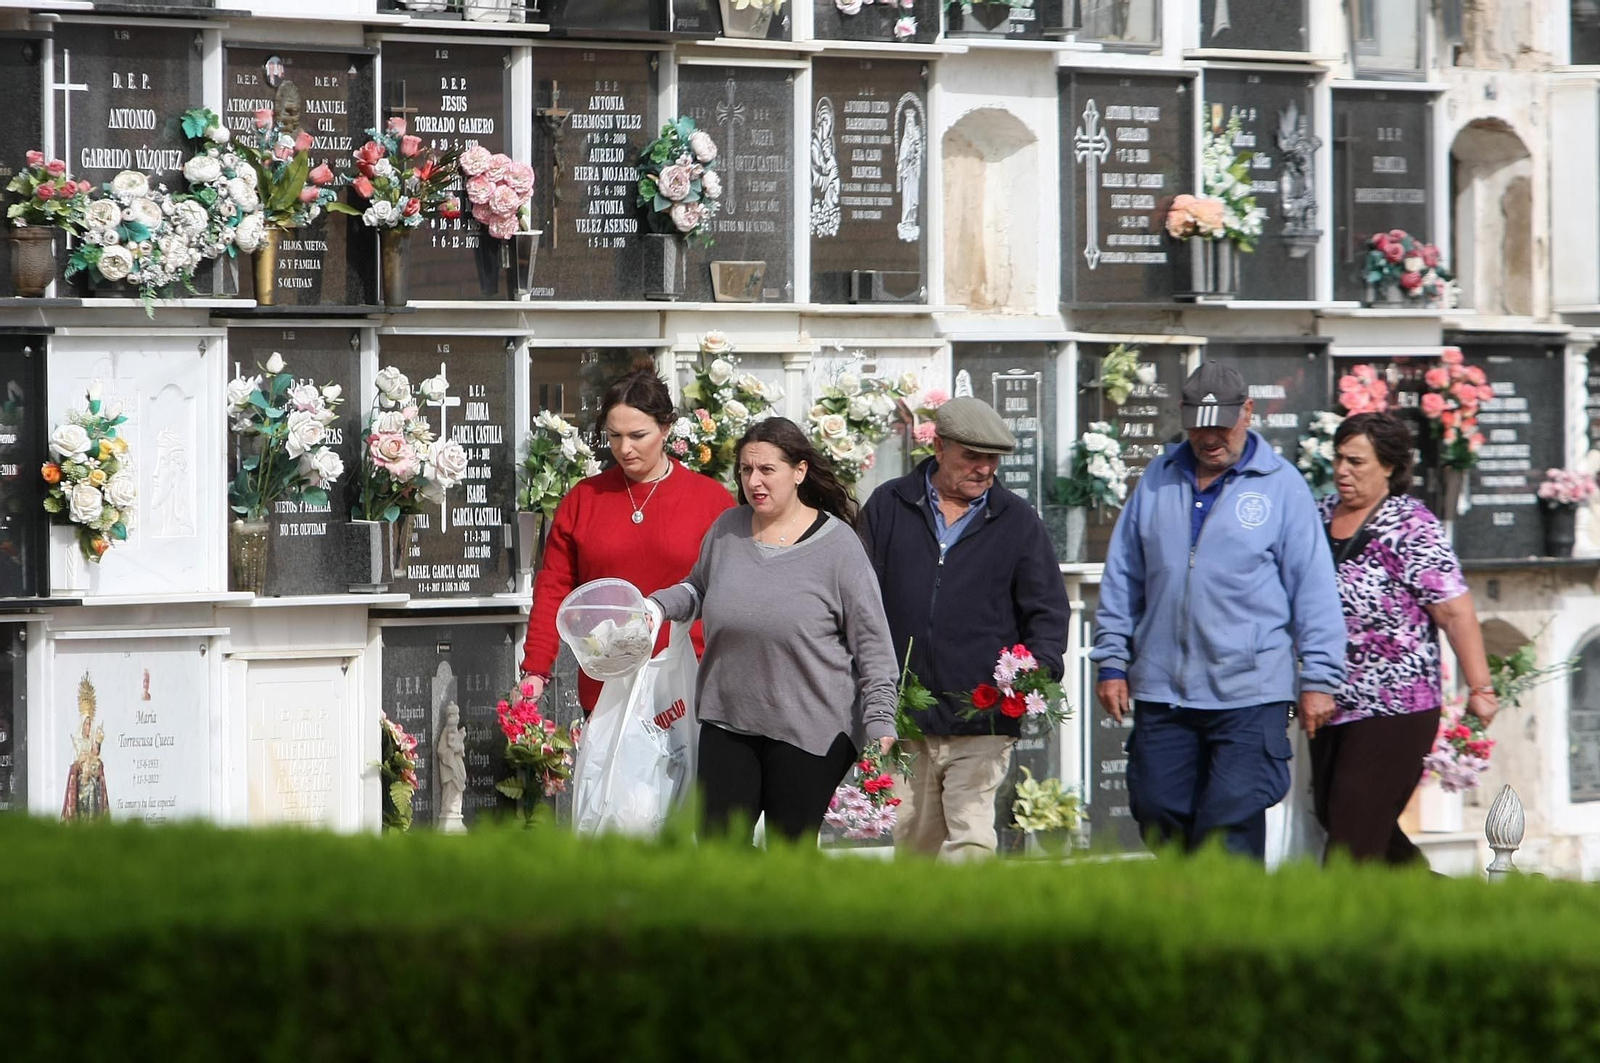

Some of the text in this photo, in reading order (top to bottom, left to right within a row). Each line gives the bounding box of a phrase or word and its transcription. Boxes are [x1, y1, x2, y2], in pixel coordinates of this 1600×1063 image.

[306, 100, 347, 115] MANUEL
[440, 95, 468, 112] JESUS
[588, 95, 624, 111] ANTONIA
[108, 108, 156, 130] ANTONIO
[317, 118, 335, 132] GIL
[414, 116, 494, 134] TORRADO GAMERO
[571, 114, 642, 130] HERMOSIN VELEZ
[81, 144, 183, 176] GARRIDO VÁZQUEZ
[589, 147, 625, 163] AURELIO
[574, 166, 600, 181] RIERA
[588, 200, 625, 214] ANTONIA
[575, 218, 638, 233] VELEZ ASENSIO
[465, 402, 489, 420] AURORA
[452, 425, 502, 444] GARCIA CASTILLA
[466, 484, 487, 503] ISABEL
[452, 507, 502, 526] GARCIA CASTILLA
[280, 523, 327, 536] NO TE OLVIDAN
[407, 564, 480, 579] RAFAEL GARCIA GARCIA
